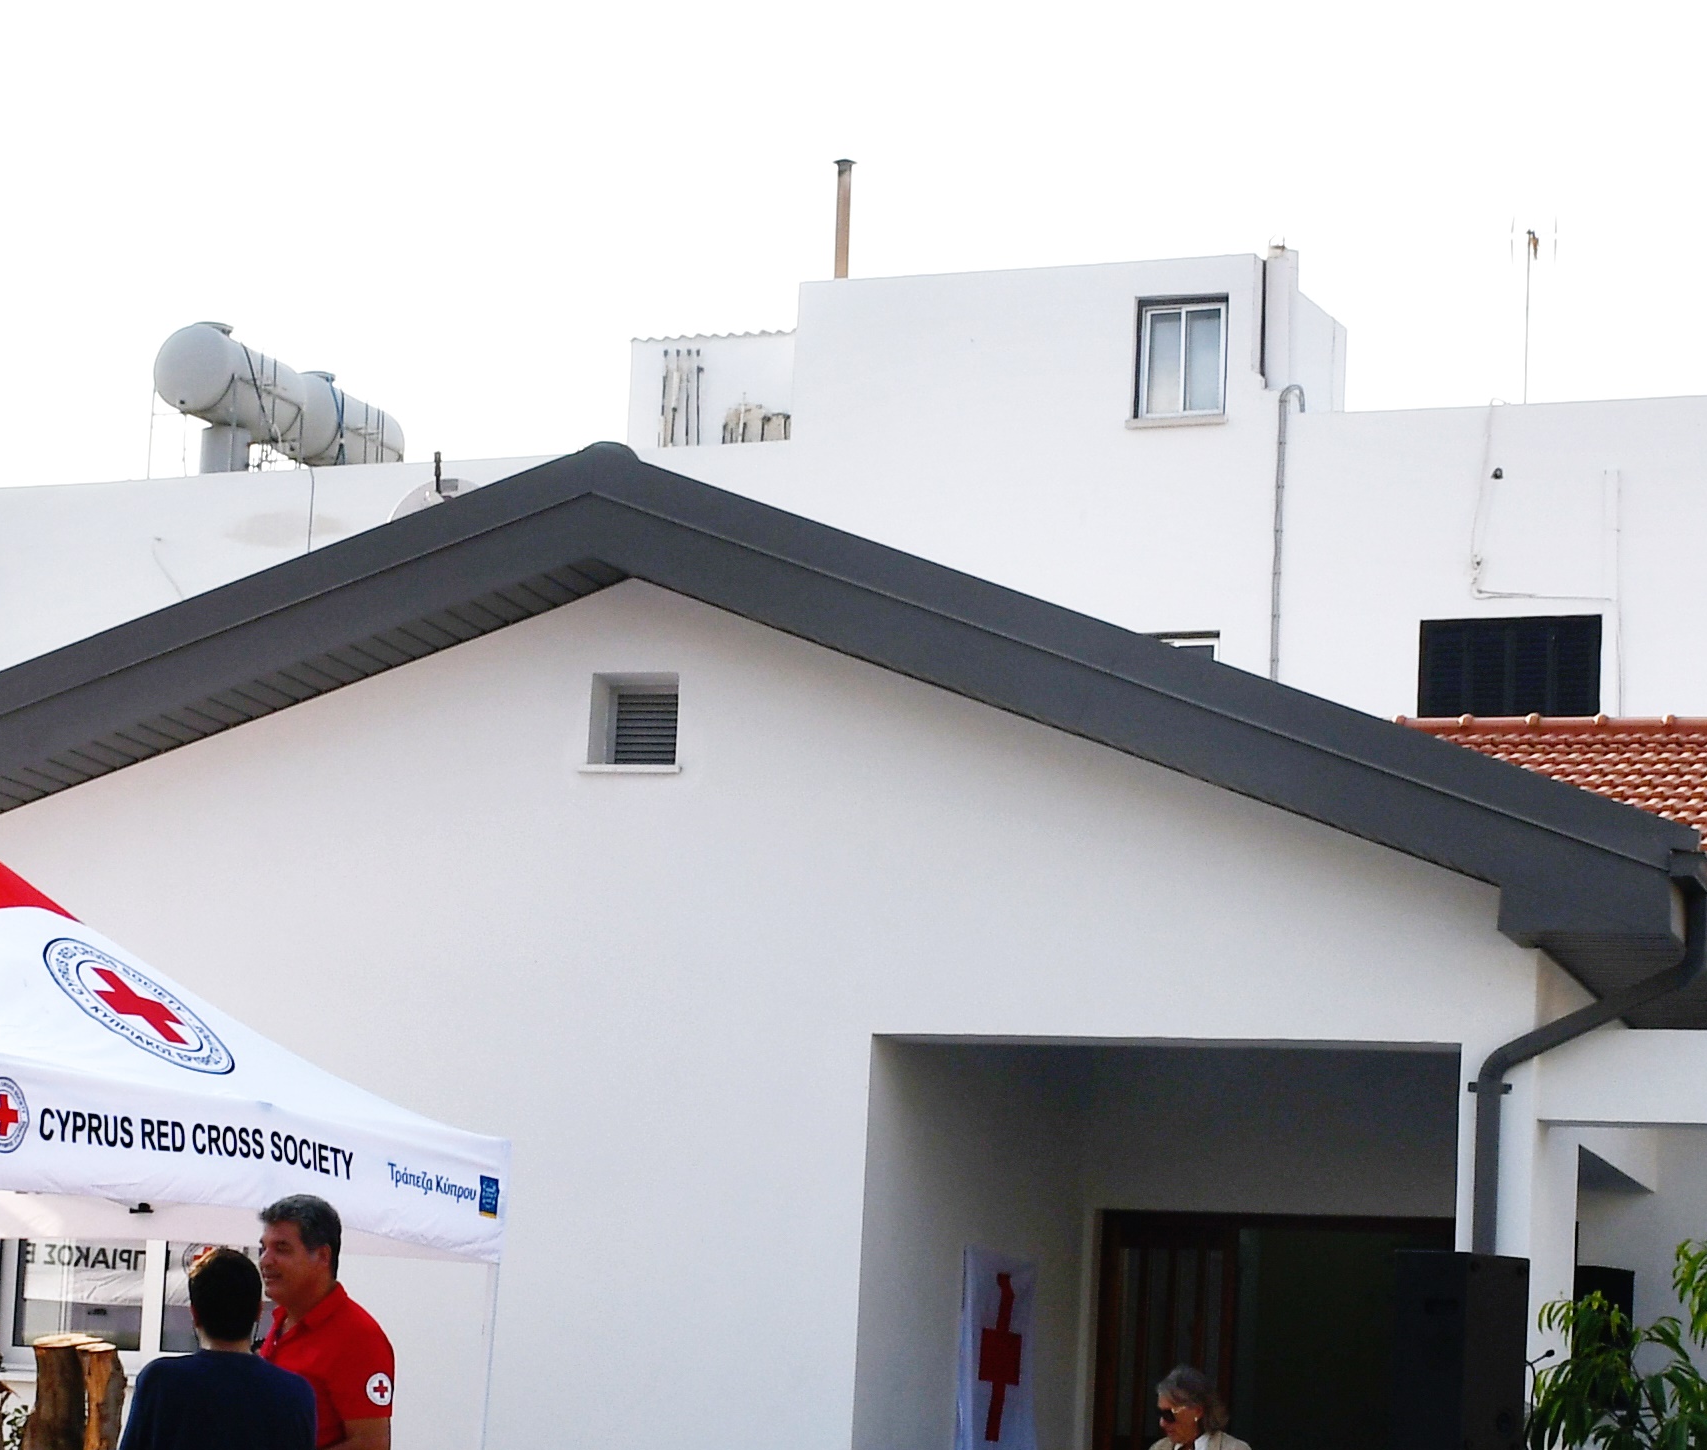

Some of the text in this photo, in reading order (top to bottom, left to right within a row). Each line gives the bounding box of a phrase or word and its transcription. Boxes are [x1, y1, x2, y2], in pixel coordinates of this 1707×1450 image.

[39, 1108, 133, 1148] CYPRUS
[141, 1118, 185, 1152] RED
[192, 1123, 264, 1159] CROSS
[271, 1131, 353, 1180] SOCIETY
[388, 1162, 433, 1195] Τράπεζα
[436, 1175, 476, 1203] Κύπρου
